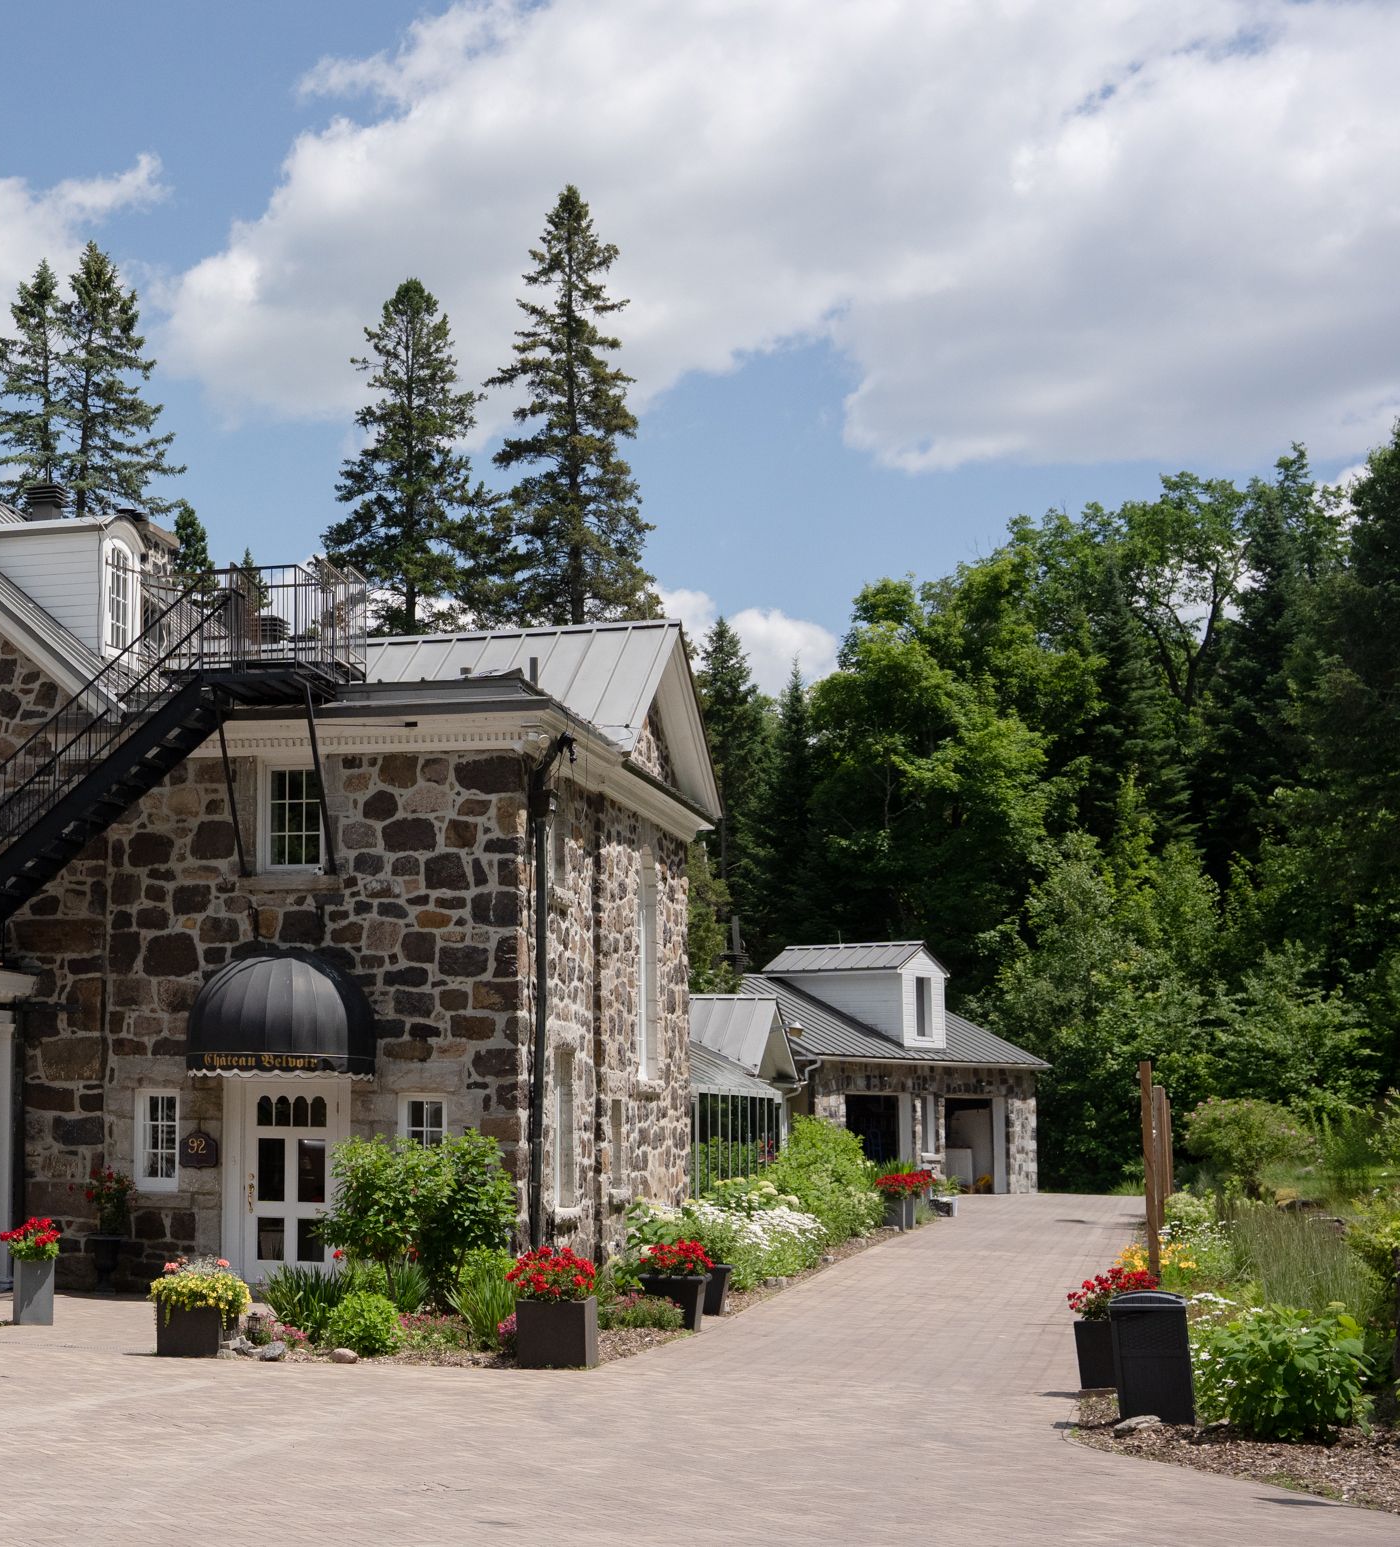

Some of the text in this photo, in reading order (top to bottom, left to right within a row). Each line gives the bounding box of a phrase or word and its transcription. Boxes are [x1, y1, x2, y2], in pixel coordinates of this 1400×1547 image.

[204, 1053, 318, 1068] Château Belvoir
[188, 1138, 207, 1153] 92
